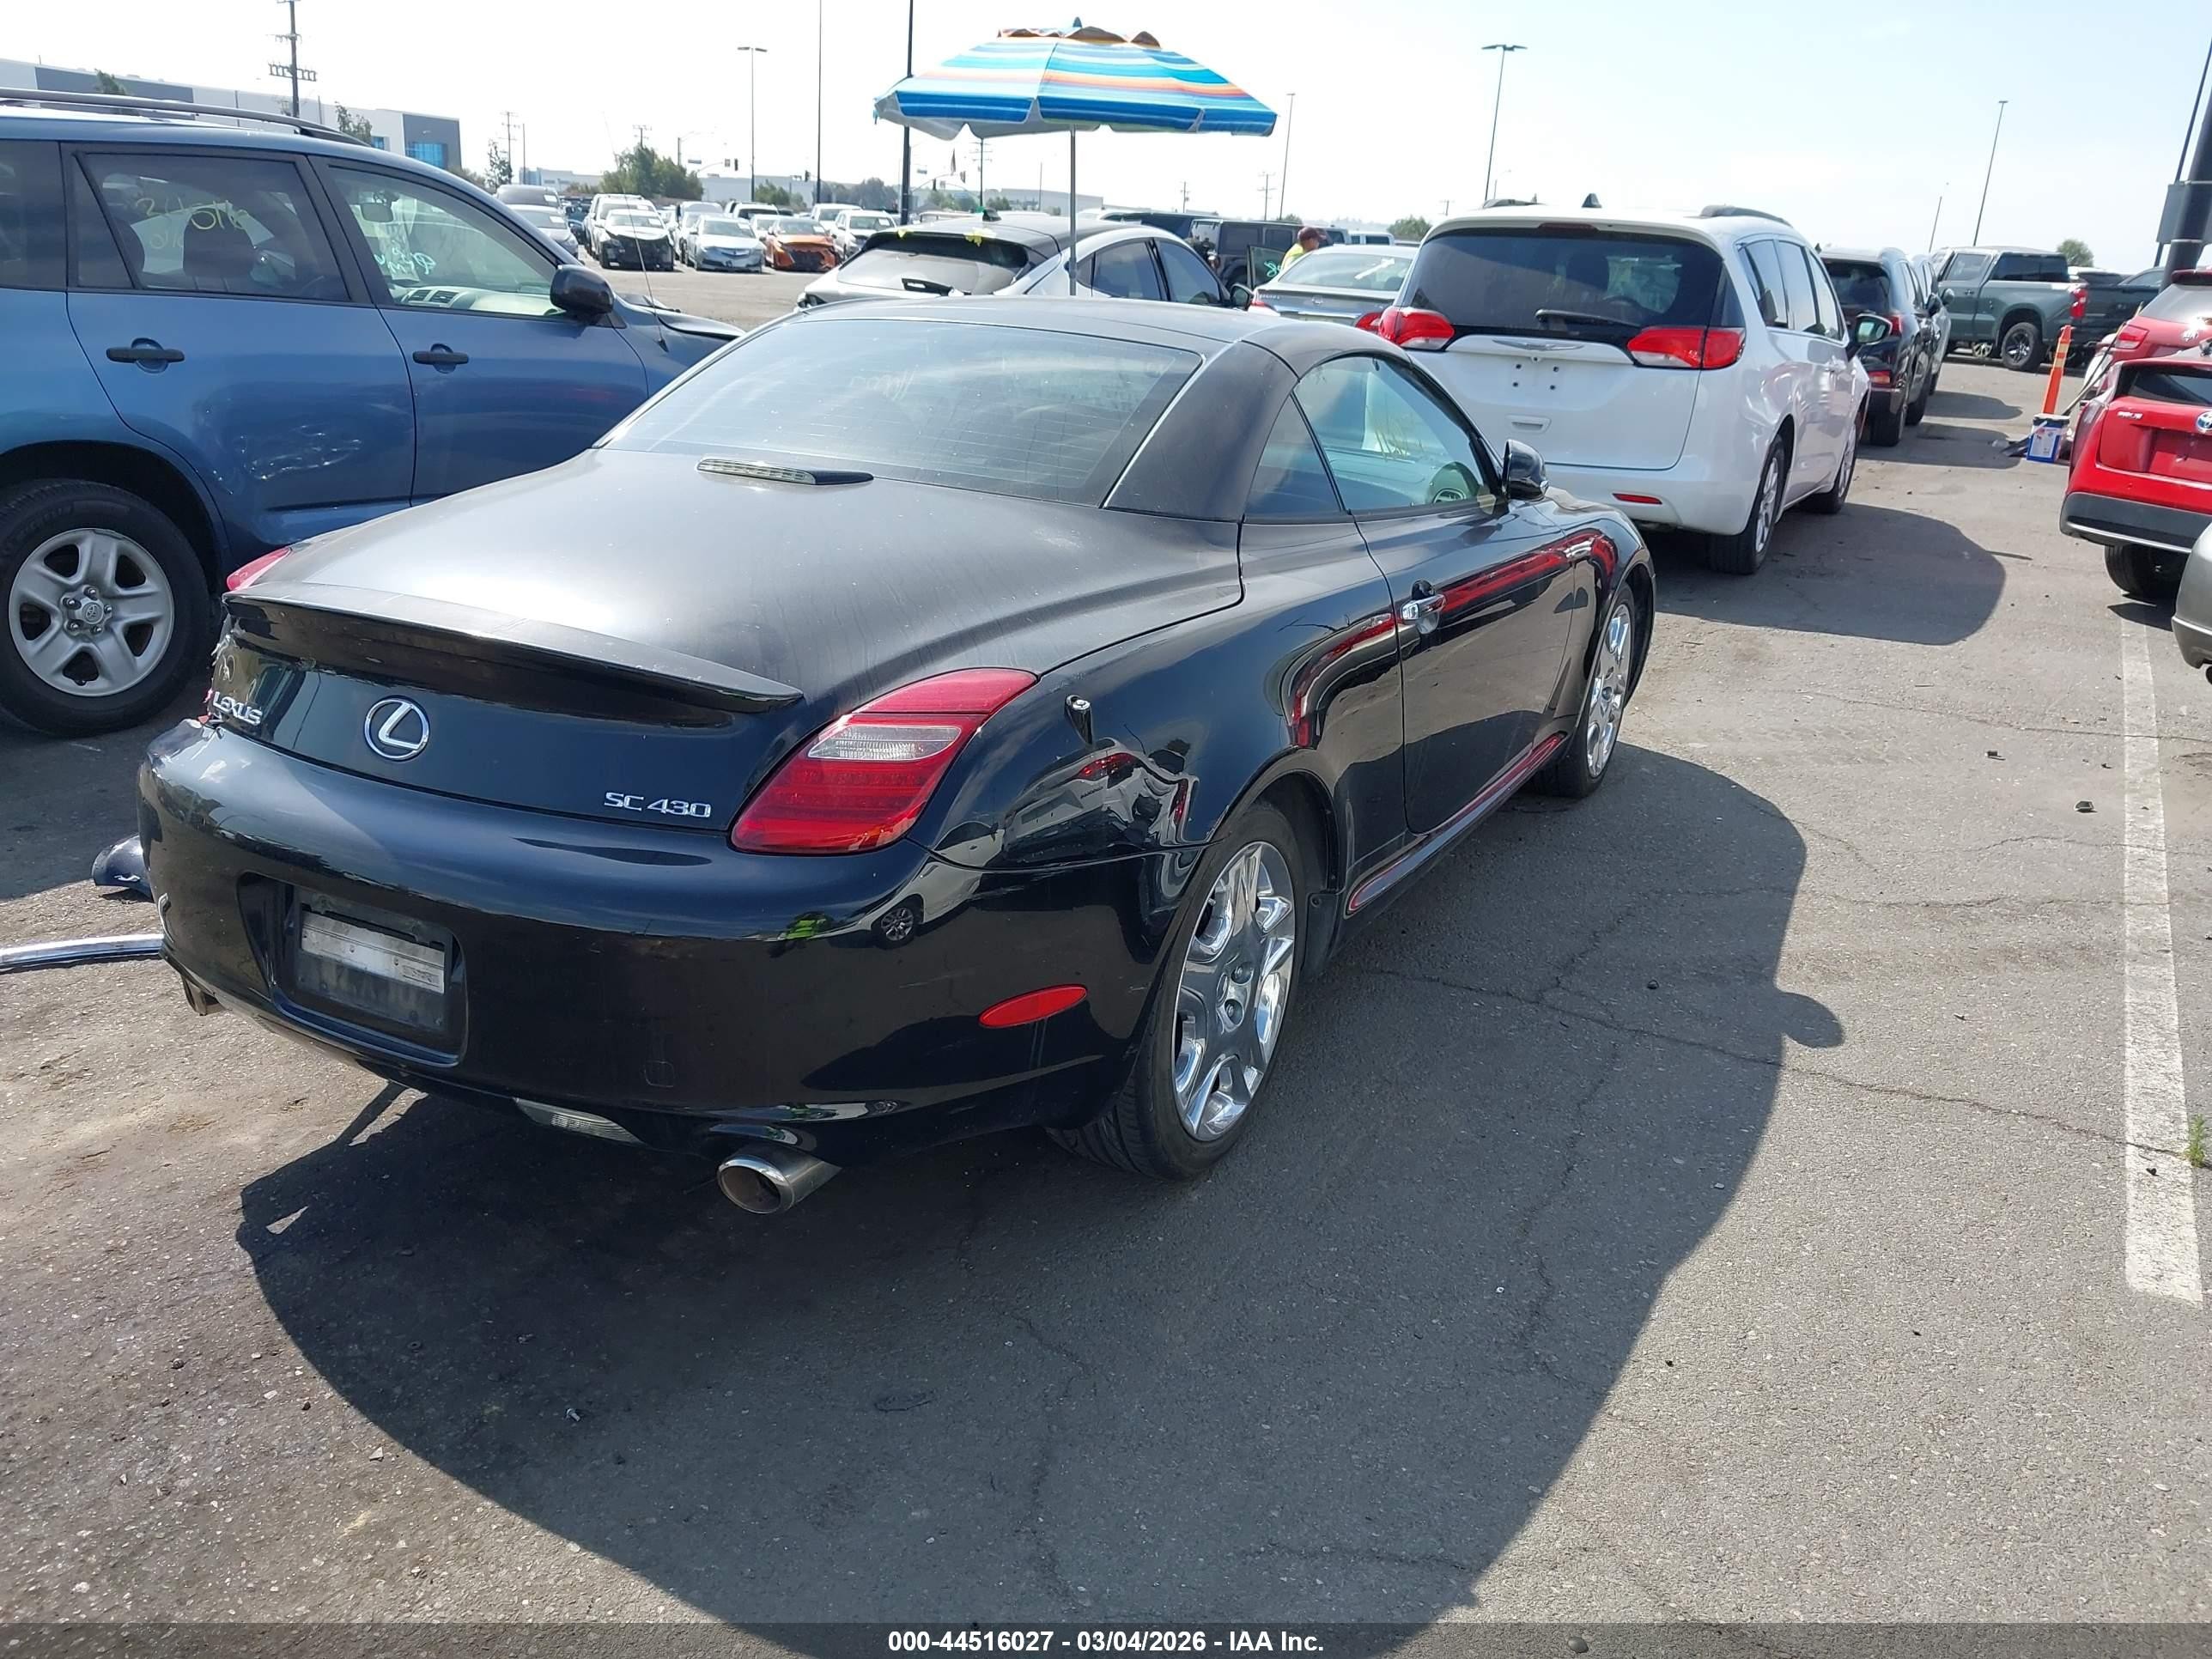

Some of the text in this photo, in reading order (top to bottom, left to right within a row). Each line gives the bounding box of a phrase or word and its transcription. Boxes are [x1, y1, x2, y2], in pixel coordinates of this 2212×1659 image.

[213, 691, 263, 726] LEXUS
[604, 792, 712, 817] SC 430
